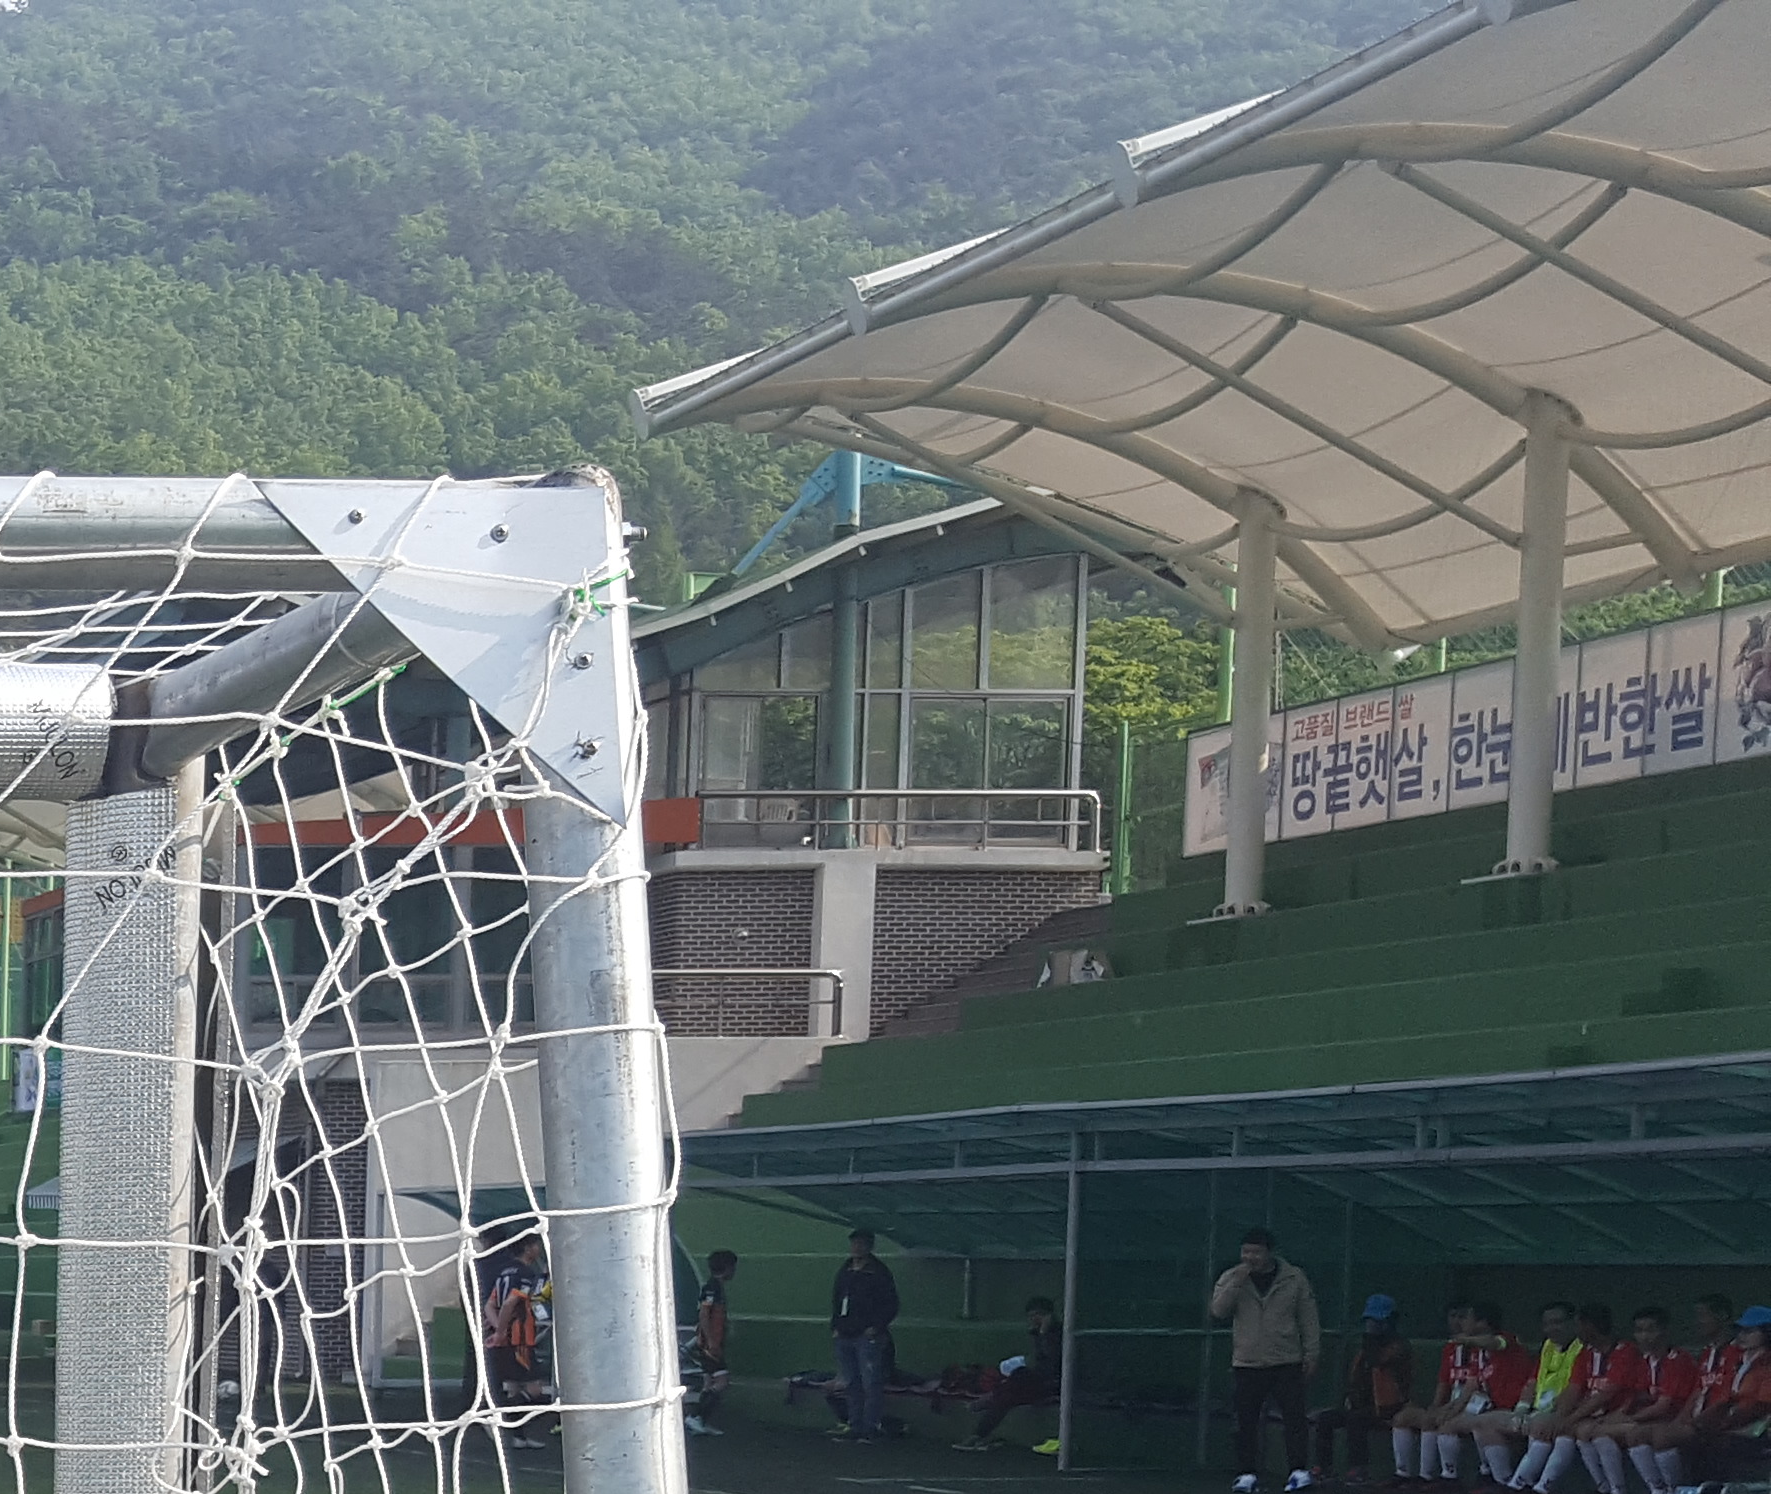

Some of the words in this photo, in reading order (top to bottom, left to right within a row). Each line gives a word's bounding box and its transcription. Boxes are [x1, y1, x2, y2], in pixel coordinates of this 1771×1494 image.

[1291, 709, 1336, 743] 고품질
[1344, 700, 1391, 730] 브랜드
[1398, 693, 1414, 720] 쌀
